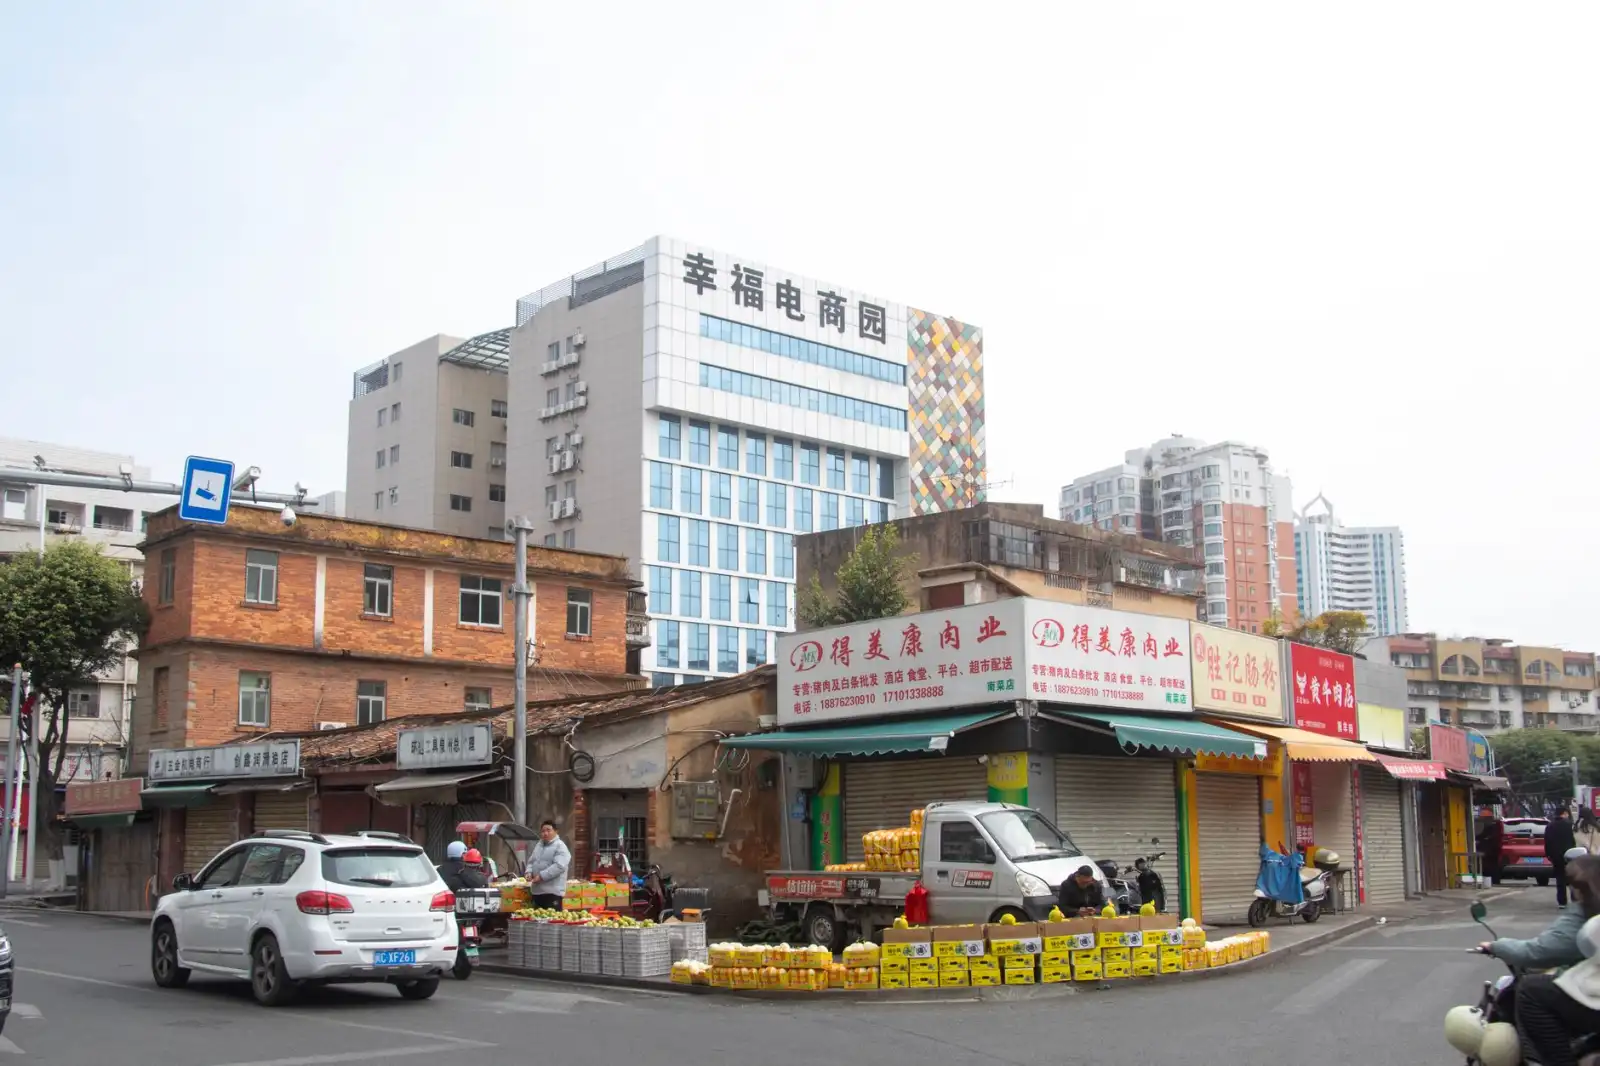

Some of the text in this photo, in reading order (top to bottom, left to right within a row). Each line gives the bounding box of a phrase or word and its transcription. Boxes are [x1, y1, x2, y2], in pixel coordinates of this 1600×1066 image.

[683, 252, 886, 345] 幸福电商园
[831, 615, 1007, 668] 得美康肉业
[1071, 623, 1184, 660] 得美康肉业
[884, 669, 904, 685] 酒店
[1103, 671, 1117, 683] 酒店
[1206, 644, 1278, 692] 胜记肠粉
[882, 685, 944, 704] 17101338888
[986, 678, 1015, 693] 南菜店
